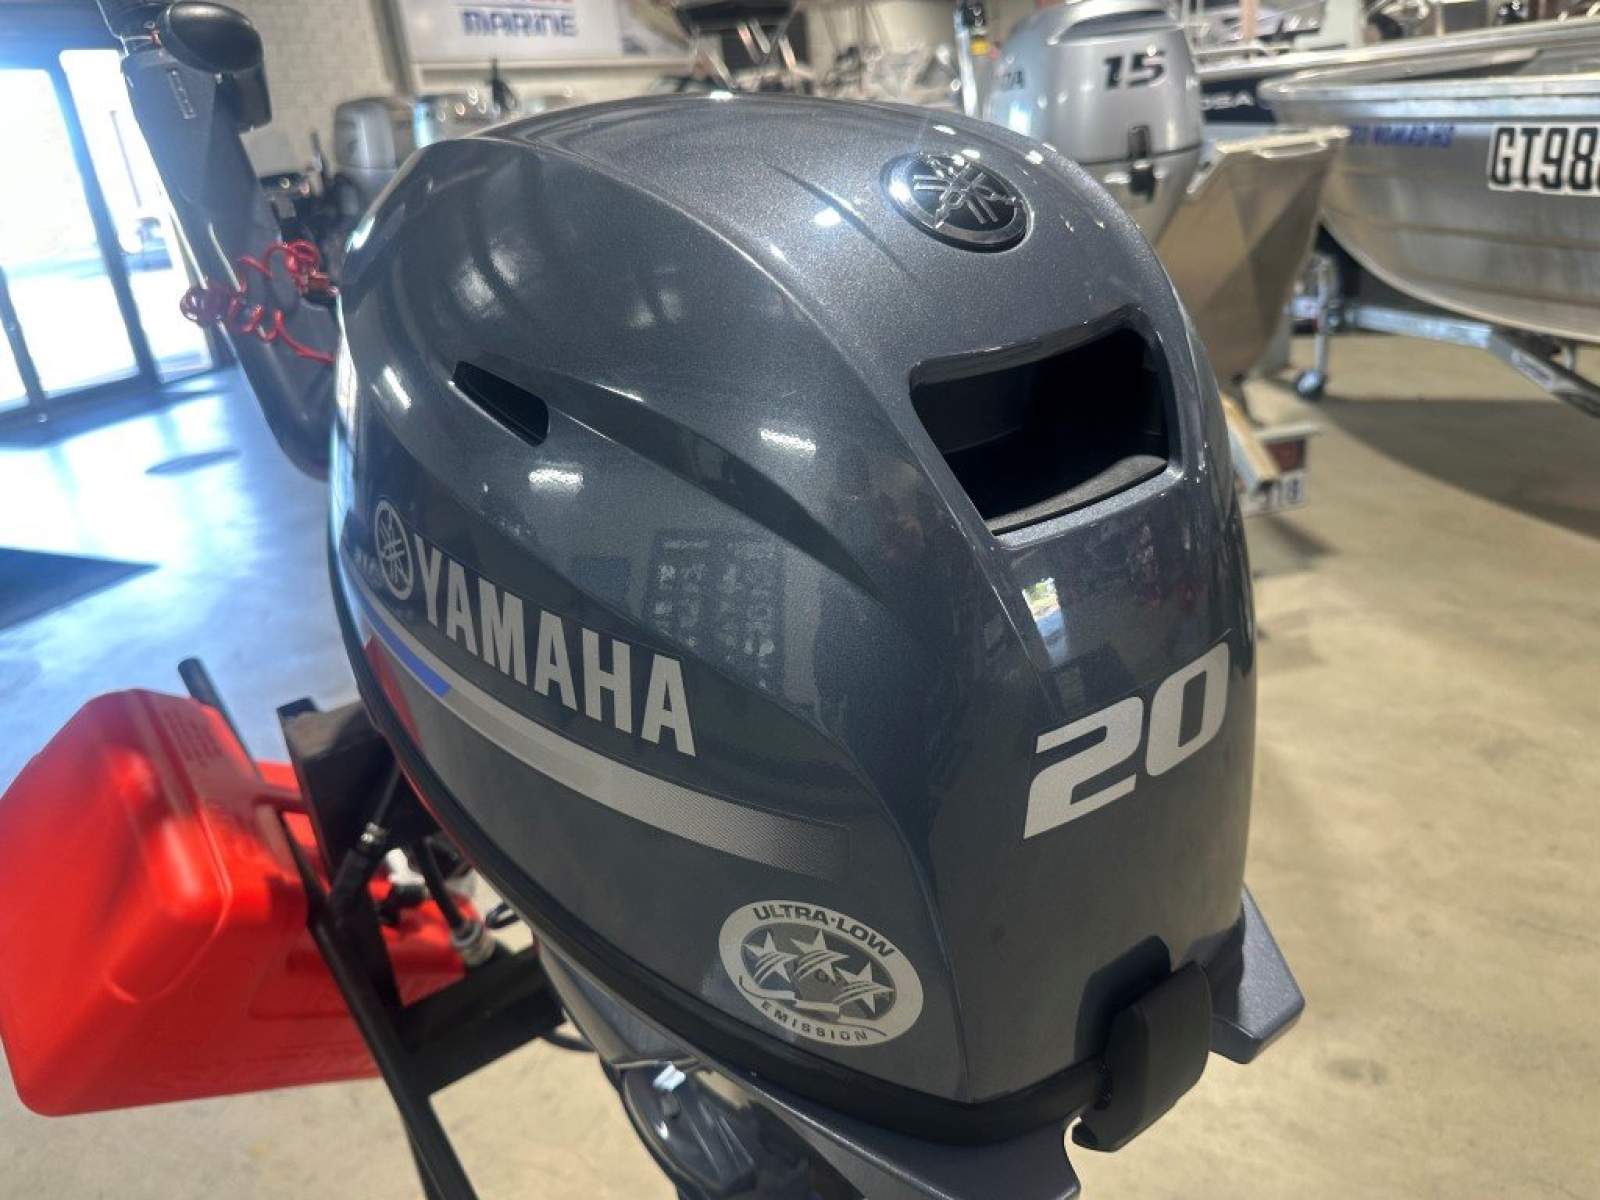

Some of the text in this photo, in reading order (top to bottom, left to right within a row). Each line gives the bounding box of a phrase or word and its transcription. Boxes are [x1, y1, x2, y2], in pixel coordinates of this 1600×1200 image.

[1103, 52, 1167, 90] 15
[1491, 126, 1600, 190] GT98
[414, 533, 696, 757] YAMAHA
[1023, 642, 1229, 840] 20
[760, 1000, 868, 1041] EMISSION
